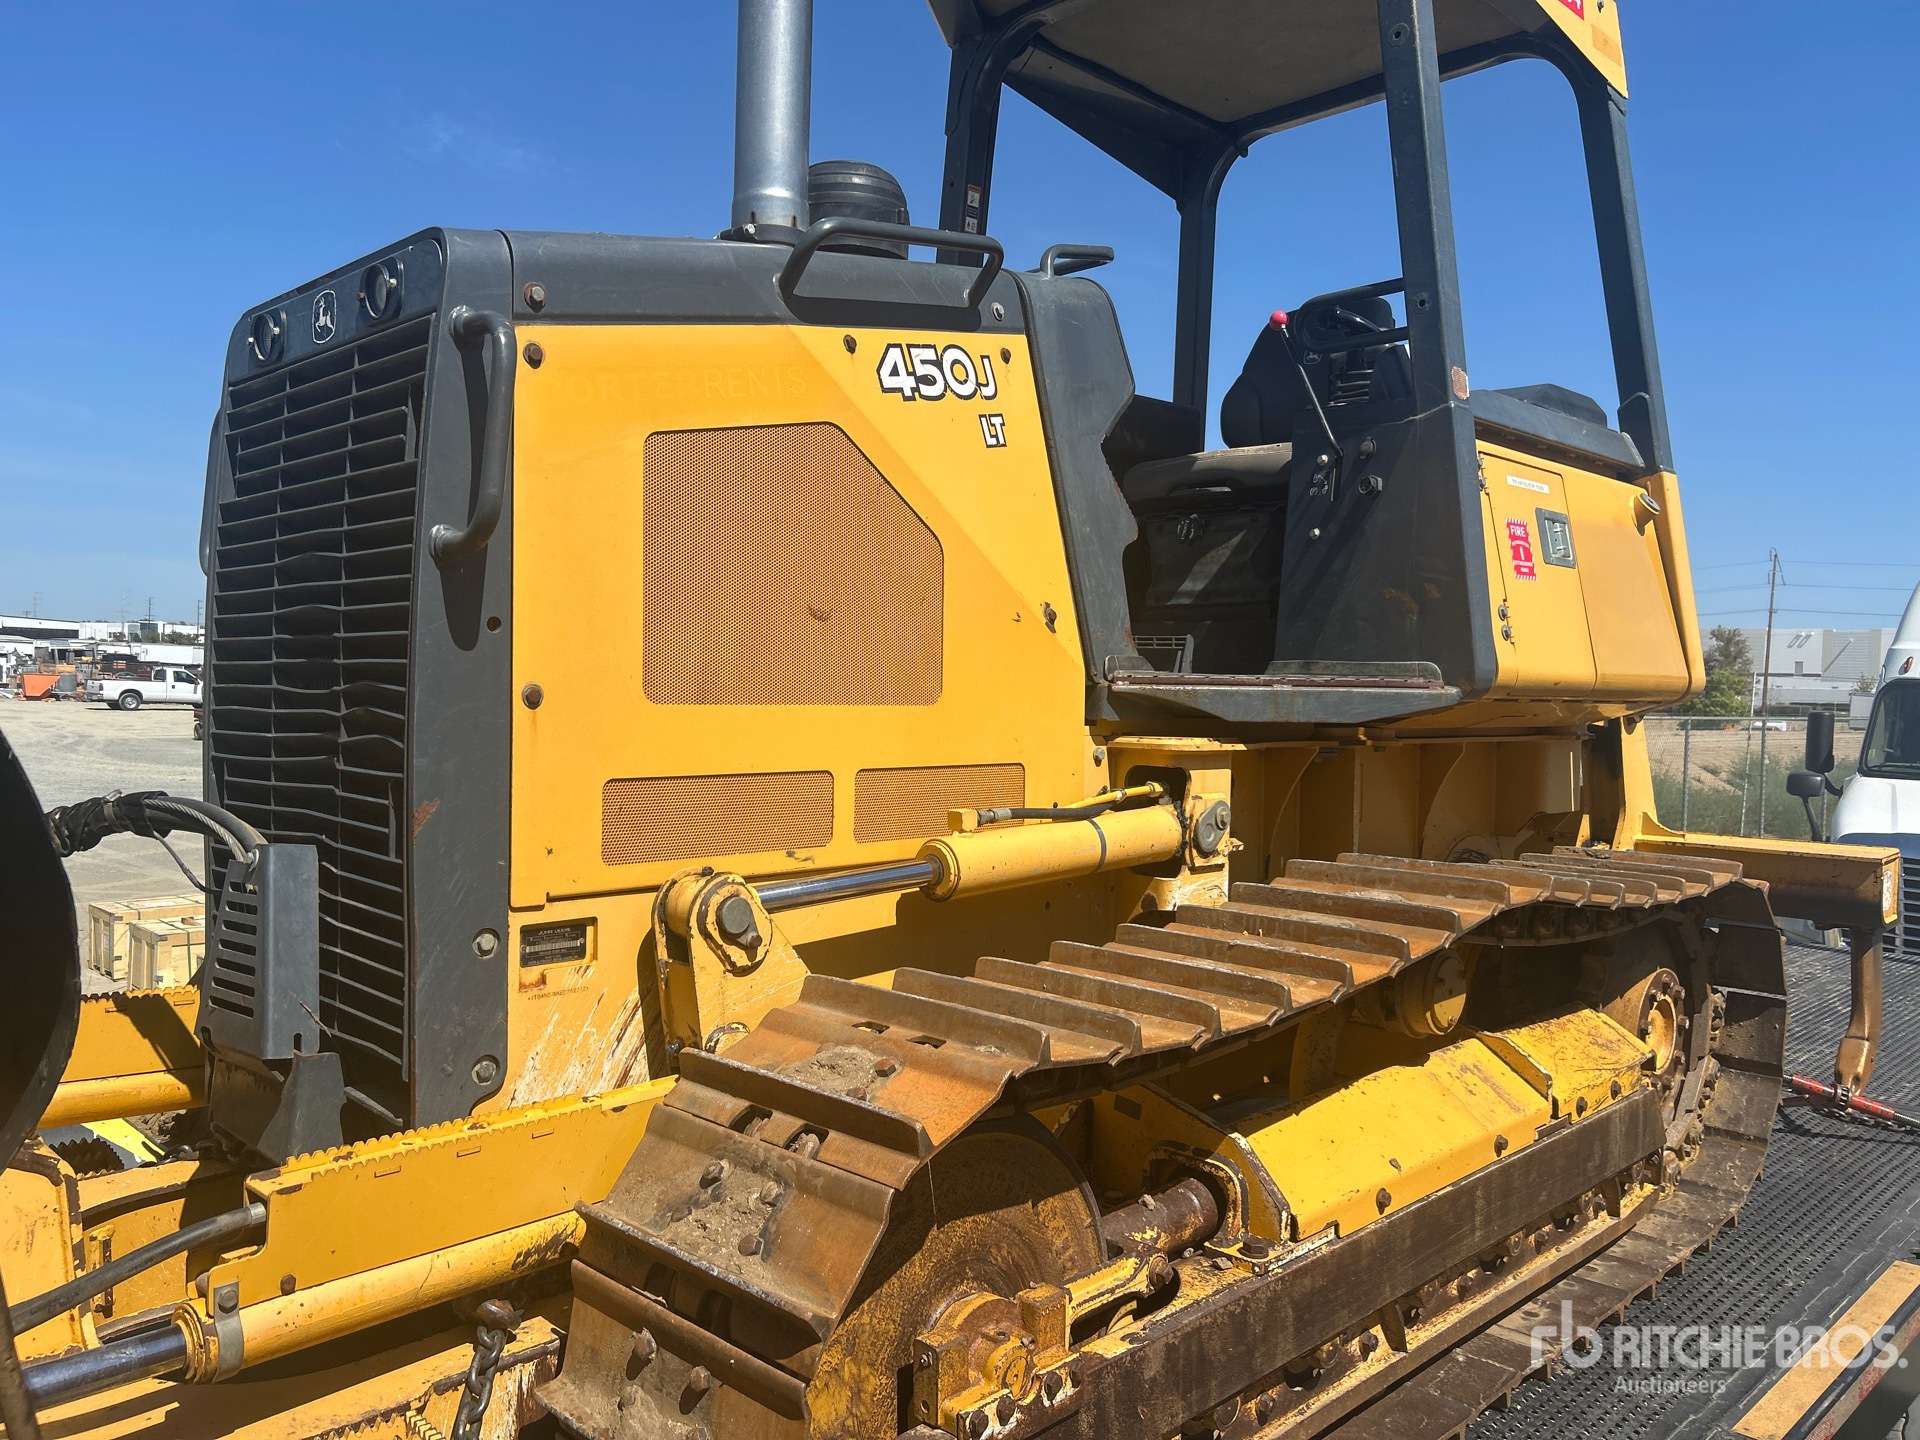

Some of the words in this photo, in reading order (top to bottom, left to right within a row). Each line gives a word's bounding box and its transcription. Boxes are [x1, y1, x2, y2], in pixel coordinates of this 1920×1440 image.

[876, 343, 998, 401] 450J
[978, 413, 1007, 448] LT
[1510, 525, 1526, 537] FIRE
